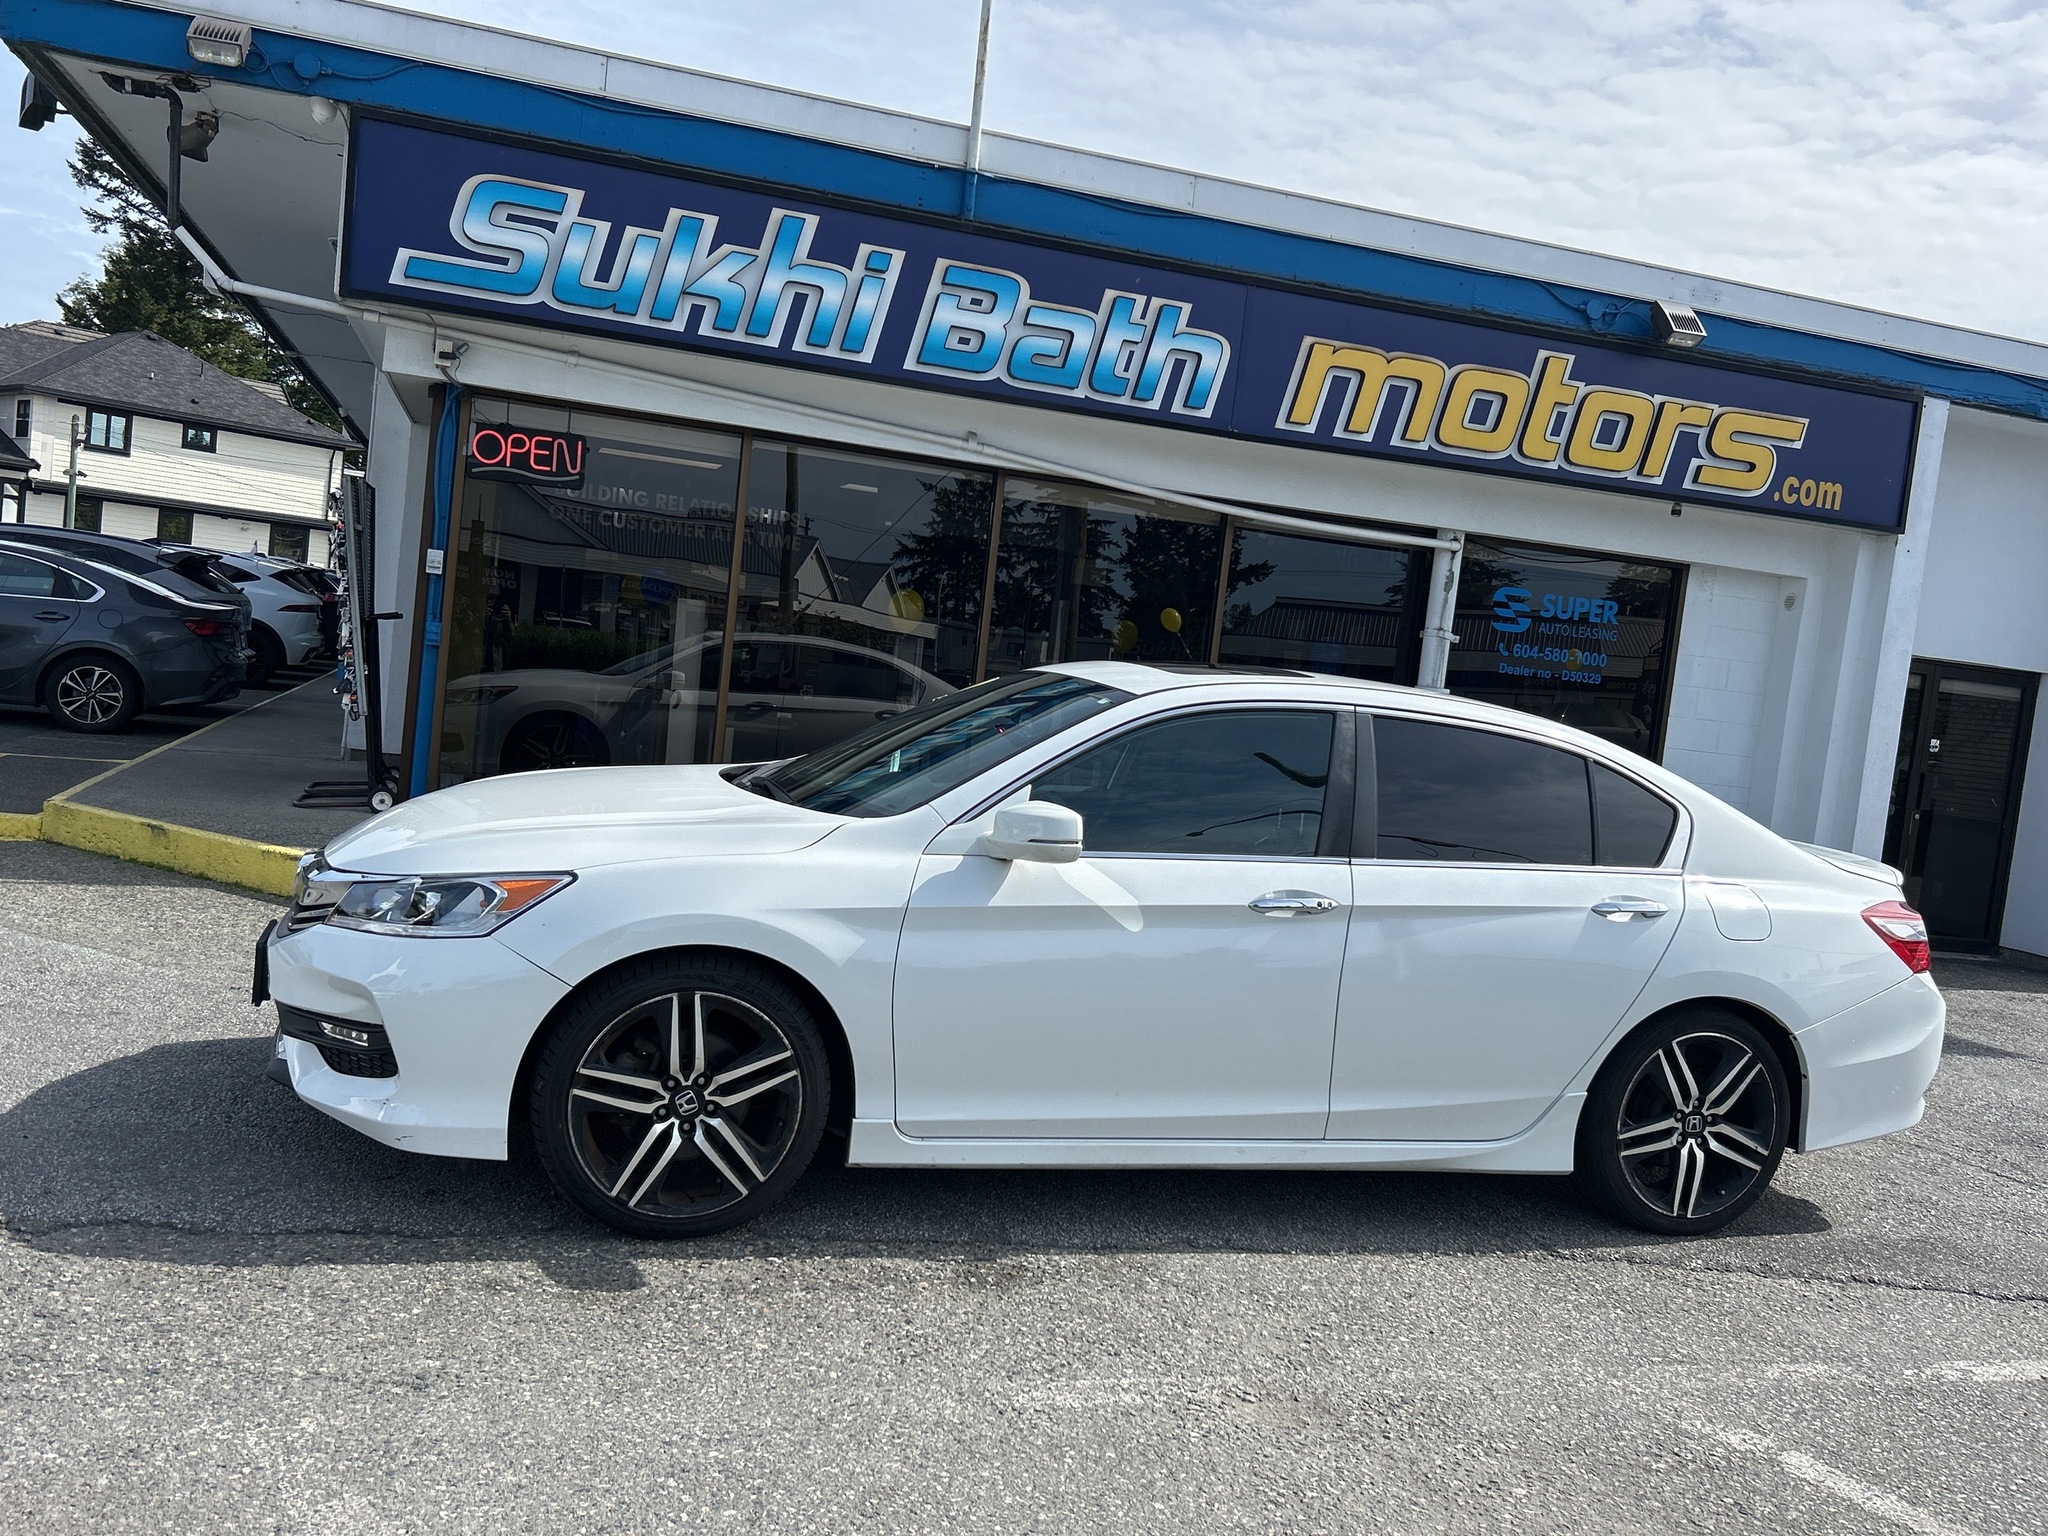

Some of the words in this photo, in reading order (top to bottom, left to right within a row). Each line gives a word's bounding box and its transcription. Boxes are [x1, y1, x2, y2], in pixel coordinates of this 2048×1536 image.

[390, 173, 906, 363] Sukhi
[904, 256, 1231, 419] Bath
[1275, 334, 1808, 499] motors
[1773, 476, 1843, 511] .com
[472, 429, 582, 475] OPEN
[598, 510, 706, 538] CUSTOMER
[655, 493, 800, 528] RELATIOSHIPS
[1539, 592, 1619, 625] SUPER
[1538, 622, 1570, 637] AUTO
[1571, 625, 1618, 642] LEASING
[1512, 643, 1608, 668] 604-580-1000
[1499, 663, 1535, 677] Dealer
[1537, 670, 1551, 680] no
[1562, 670, 1602, 685] D50329
[732, 982, 784, 1013] BEARWAY
